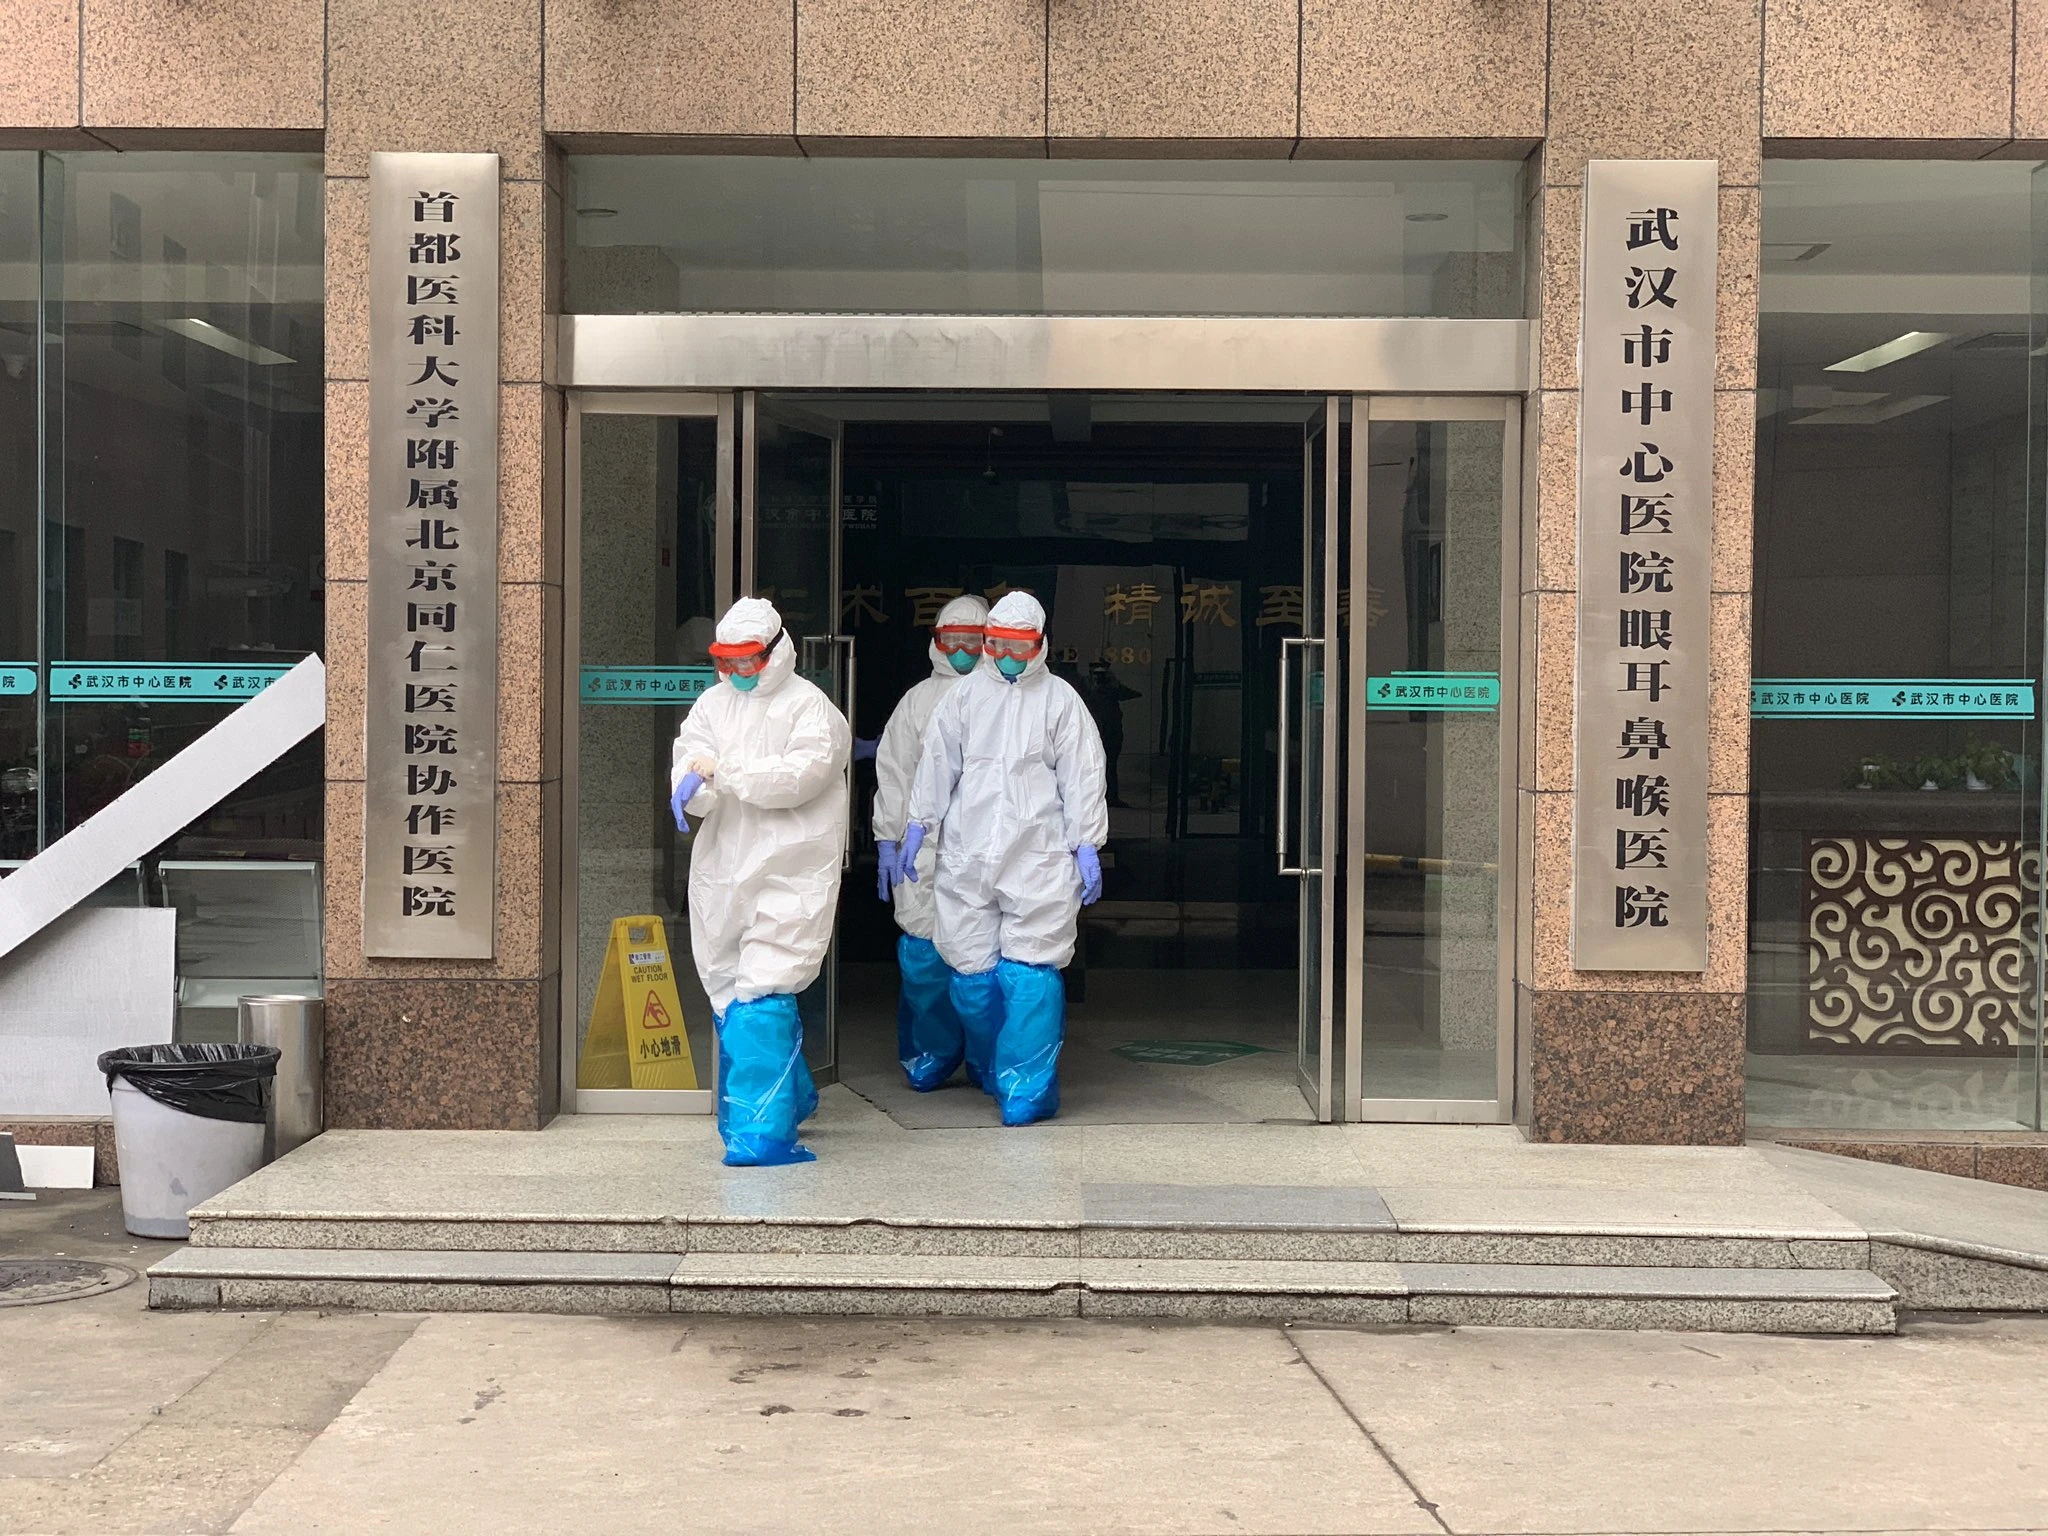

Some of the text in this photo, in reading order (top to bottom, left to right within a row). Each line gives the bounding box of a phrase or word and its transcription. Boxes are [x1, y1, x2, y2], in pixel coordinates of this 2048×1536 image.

[401, 190, 462, 917] 首都医科大学附属北京同仁医院协作医院
[1615, 207, 1680, 928] 武汉市中心医院眼耳鼻喉医院
[86, 675, 193, 689] 武汉市中心医院
[605, 677, 707, 692] 武汉市中心医院
[1395, 685, 1491, 699] 武汉市中心医院
[1760, 691, 1870, 706] 武汉市中心医院
[1910, 692, 2019, 707] 武汉市中心医院
[631, 972, 668, 983] WET FLOOR
[634, 965, 663, 975] CAUTION
[640, 1035, 681, 1059] 小心地滑
